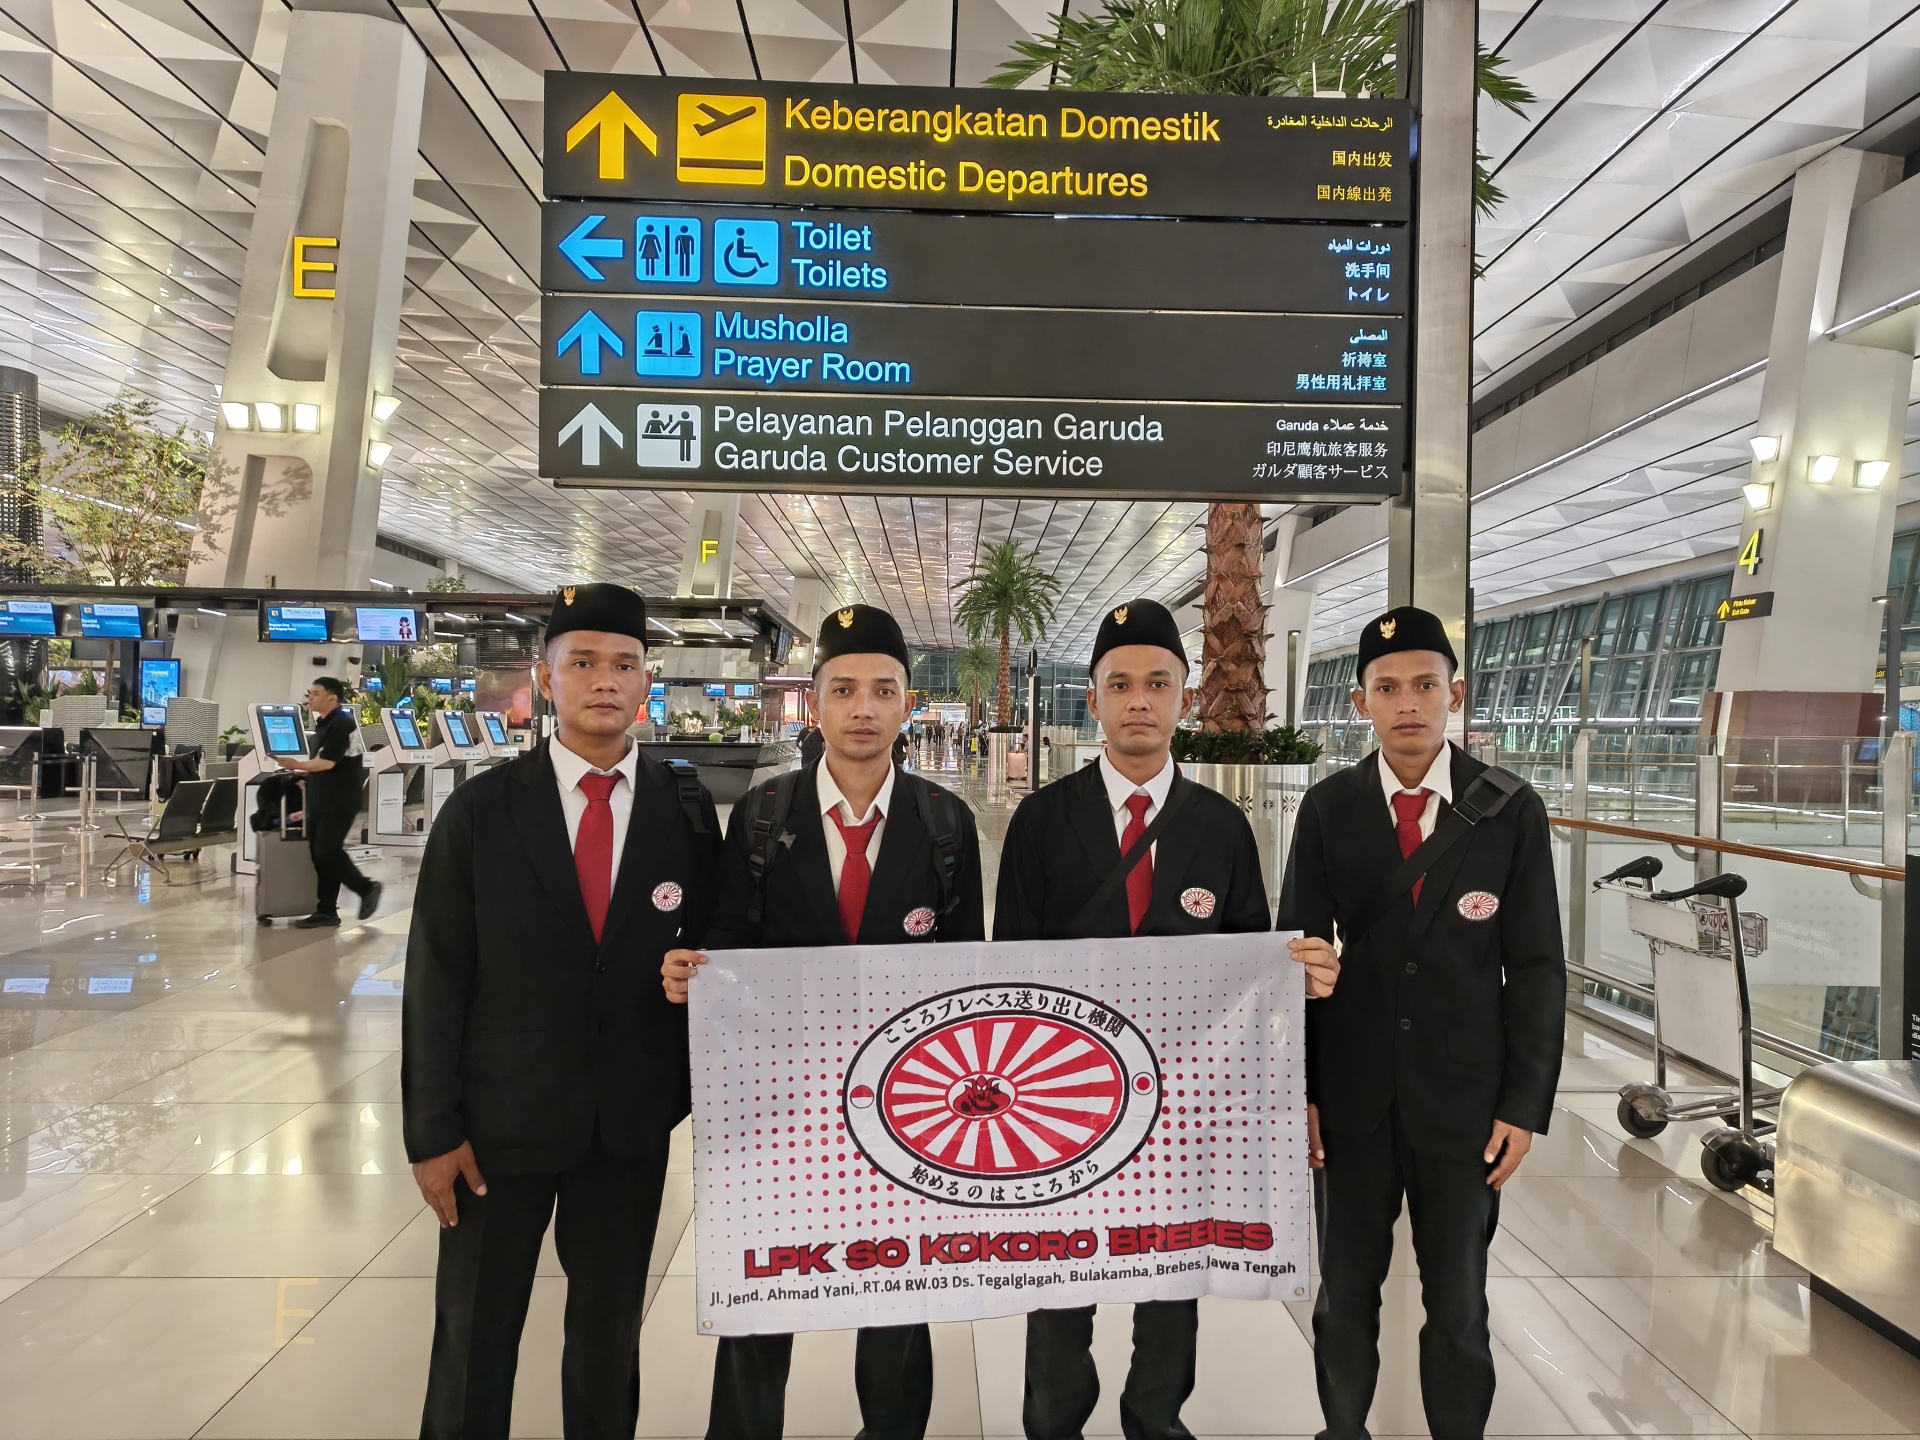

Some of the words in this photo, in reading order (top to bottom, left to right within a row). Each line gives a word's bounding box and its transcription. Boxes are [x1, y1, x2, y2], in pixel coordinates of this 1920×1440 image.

[784, 97, 1047, 143] Keberangkatan
[1060, 107, 1221, 142] Domestik
[1267, 114, 1307, 129] المغادرة
[1310, 115, 1347, 130] الداخلية
[1350, 116, 1393, 132] الرحلات
[1332, 150, 1393, 168] 国内出发
[784, 154, 947, 192] Domestic
[958, 161, 1148, 201] Departures
[1317, 184, 1392, 202] 国内線出発
[790, 220, 872, 252] Toilet
[1327, 238, 1353, 254] المياه
[1355, 239, 1391, 255] دورات
[292, 236, 340, 298] E
[790, 258, 888, 291] Toilets
[1344, 261, 1391, 279] 洗手间
[1348, 286, 1390, 302] トイレ
[714, 311, 849, 343] Musholla
[1349, 328, 1389, 344] المصلى
[714, 348, 814, 385] Prayer
[821, 353, 911, 383] Room
[1341, 351, 1388, 368] 祈祷室
[1295, 373, 1387, 391] 男性用礼拝室
[714, 405, 873, 441] Pelayanan
[883, 409, 1043, 444] Pelanggan
[1053, 413, 1164, 442] Garuda
[1275, 419, 1320, 431] Garuda
[1322, 418, 1356, 431] عملاء
[1359, 417, 1390, 431] خدمة
[1266, 440, 1389, 458] 印尼鹰航旅客服务
[714, 442, 828, 471] Garuda
[837, 445, 986, 475] Customer
[993, 448, 1103, 477] Service
[1251, 462, 1389, 480] ガルダ顧客サービス
[701, 540, 719, 564] F
[1738, 528, 1763, 575] 4
[883, 989, 1126, 1044] こころブレベス送り出し機関
[908, 1159, 1100, 1202] 始めるのはこころから
[744, 1242, 838, 1280] LPK
[845, 1237, 910, 1271] SO
[919, 1228, 1099, 1266] KOKORO
[1108, 1217, 1275, 1257] BREBES
[709, 1291, 724, 1307] Jl.
[726, 1288, 763, 1308] Jend.
[767, 1286, 819, 1301] Ahmad
[822, 1282, 859, 1298] Yani,
[863, 1279, 901, 1294] RT.04
[905, 1277, 948, 1291] RW.03
[952, 1275, 974, 1289] Ds.
[977, 1271, 1066, 1290] Tegalglagah,
[1069, 1266, 1153, 1283] Bulakamba,
[1156, 1259, 1204, 1276] Brebes,
[1206, 1255, 1240, 1272] Jawa
[1243, 1261, 1296, 1277] Tengah
